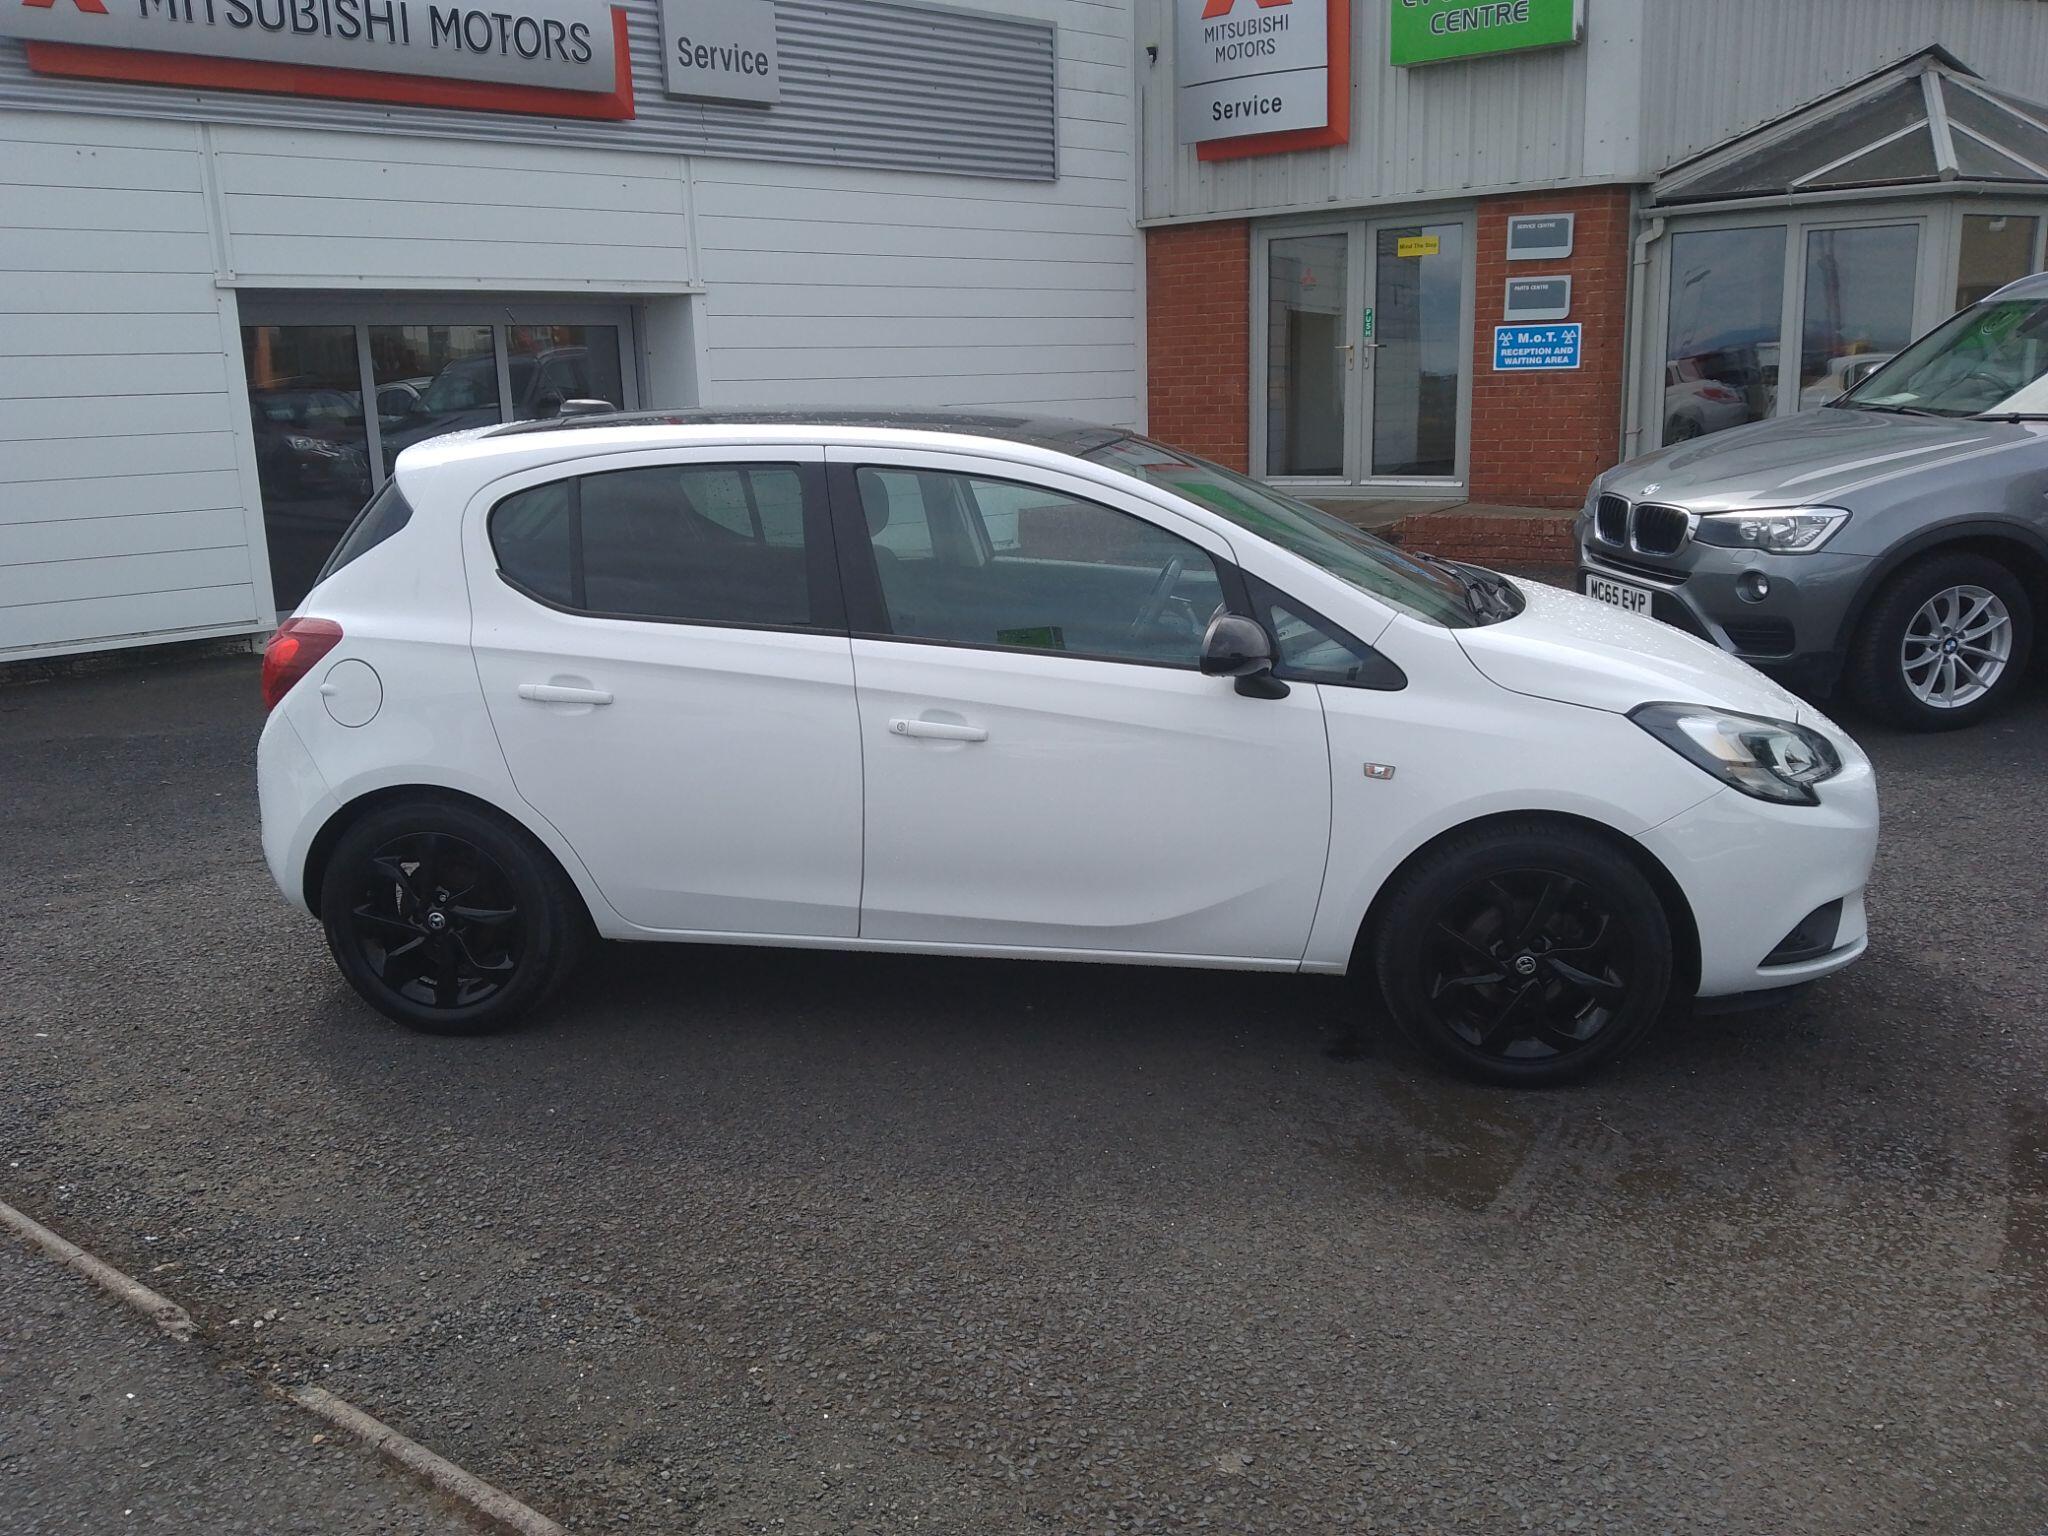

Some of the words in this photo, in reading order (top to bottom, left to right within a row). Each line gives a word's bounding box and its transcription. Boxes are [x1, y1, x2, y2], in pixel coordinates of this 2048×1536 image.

[1203, 13, 1290, 44] MITSUBISHI
[1430, 0, 1530, 36] CENTRE
[427, 4, 593, 64] MOTORS
[677, 36, 770, 76] Service
[1214, 38, 1277, 63] MOTORS
[1212, 95, 1283, 121] Service
[1501, 347, 1552, 356] RECEPTION
[1553, 346, 1574, 354] AND
[1518, 332, 1557, 343] M.o.T.
[1504, 356, 1543, 365] WAITING
[1545, 355, 1569, 364] AREA
[1590, 579, 1620, 606] MC65
[1621, 588, 1647, 613] EVP
